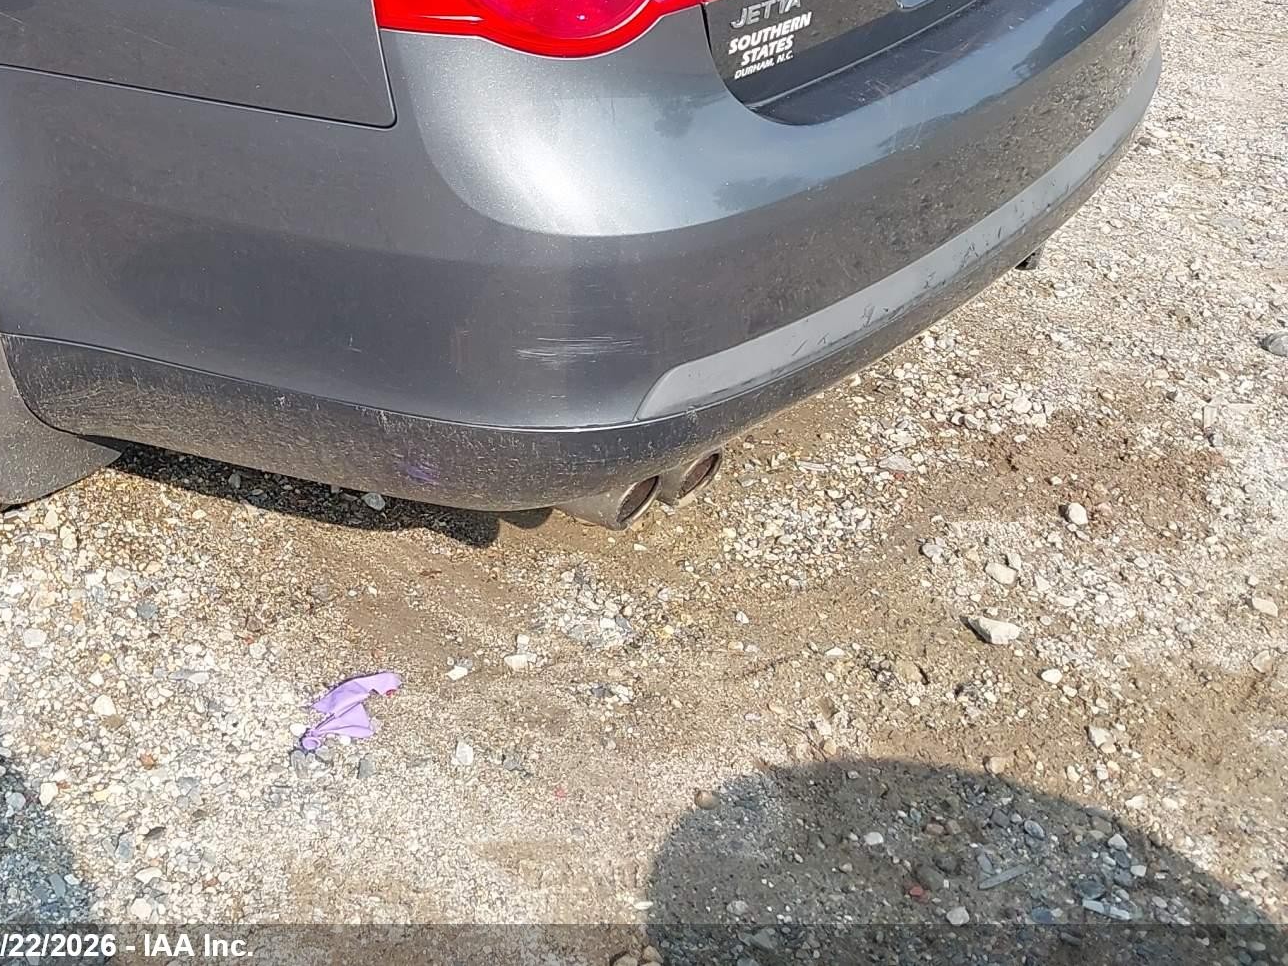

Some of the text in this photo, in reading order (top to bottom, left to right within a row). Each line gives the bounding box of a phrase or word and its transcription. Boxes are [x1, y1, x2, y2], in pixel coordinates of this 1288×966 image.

[728, 11, 813, 55] SOUTHERN
[741, 34, 794, 67] STATES
[776, 50, 794, 64] N.C.
